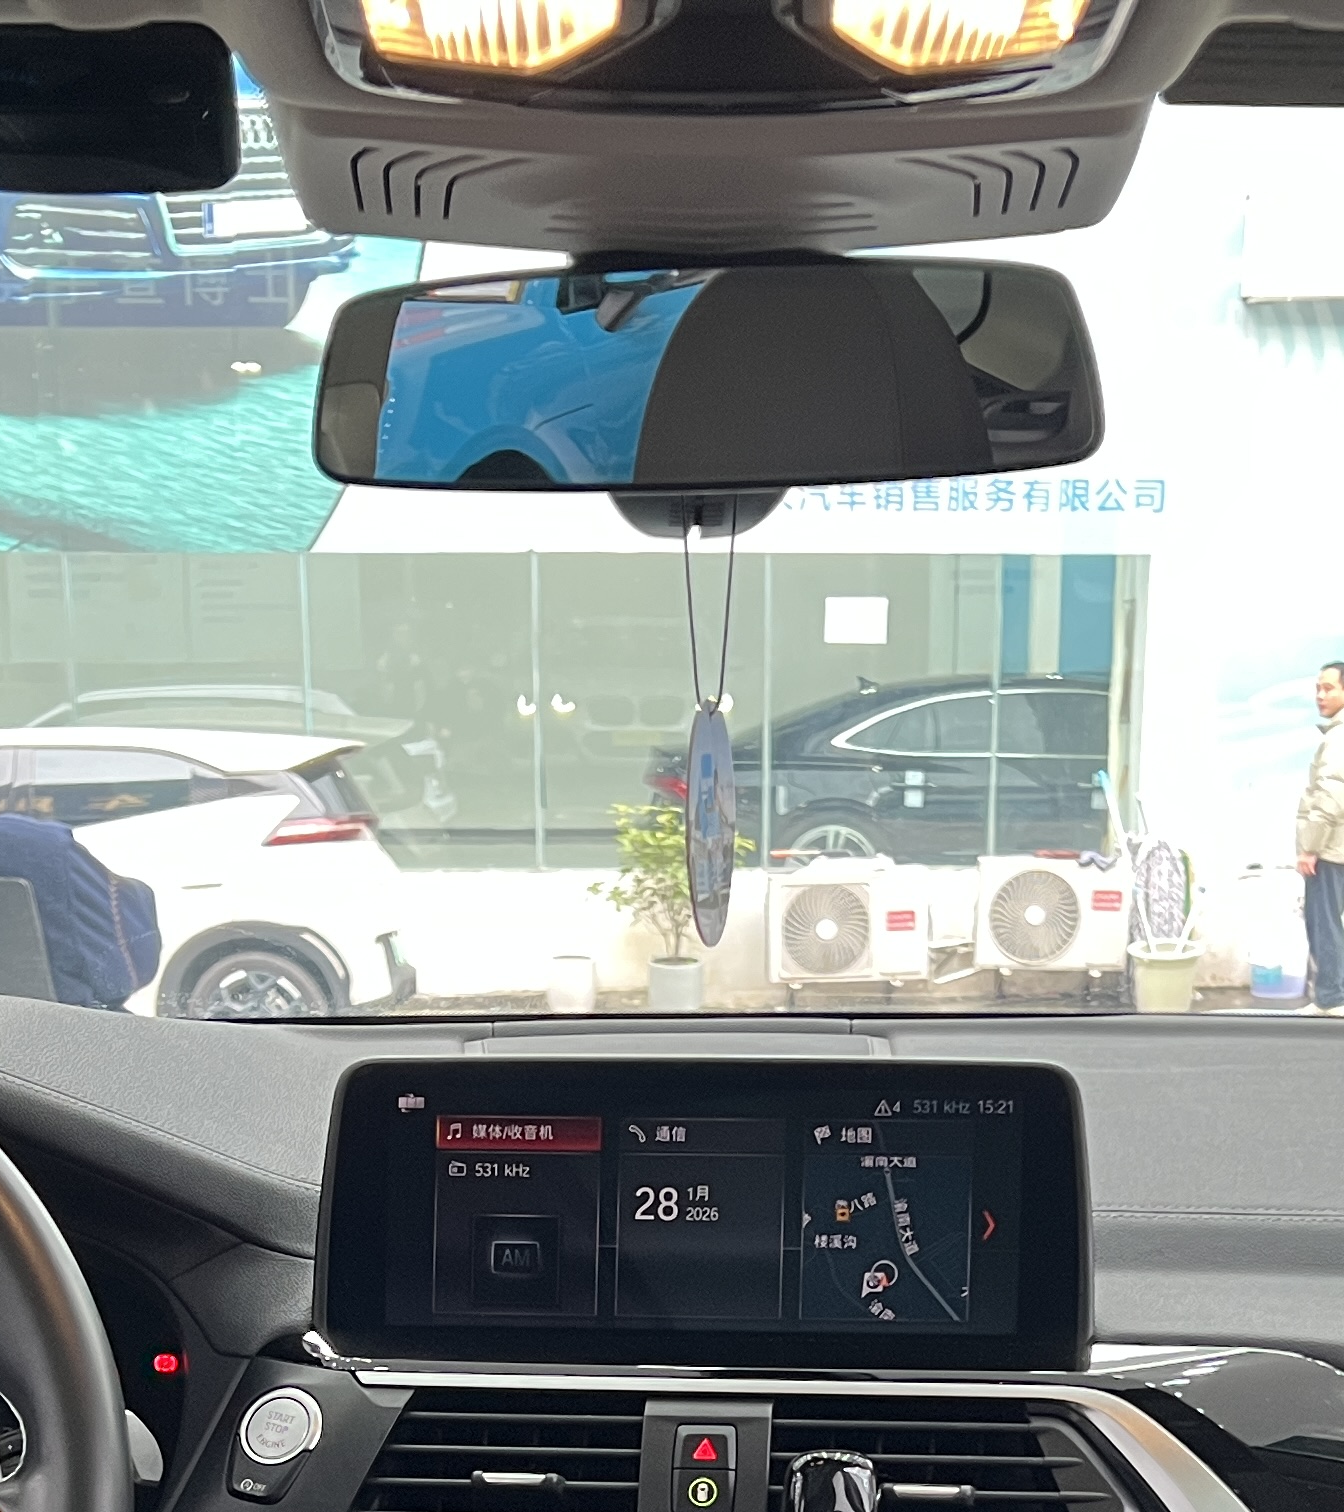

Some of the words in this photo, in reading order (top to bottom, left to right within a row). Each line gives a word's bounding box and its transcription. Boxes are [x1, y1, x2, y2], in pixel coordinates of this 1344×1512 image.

[783, 477, 1166, 513] 汽车销售服务有限公司
[912, 1100, 938, 1114] 531
[943, 1100, 970, 1114] kHz
[978, 1100, 1014, 1114] 15:21
[471, 1123, 554, 1142] 媒体/收音机
[655, 1125, 687, 1143] 通信
[840, 1127, 872, 1143] 地图
[474, 1163, 499, 1178] 531
[504, 1163, 531, 1179] kHz
[686, 1185, 709, 1202] 1月
[634, 1186, 679, 1222] 28
[685, 1207, 719, 1222] 2026
[501, 1248, 531, 1267] AM
[267, 1410, 296, 1425] START
[264, 1422, 289, 1434] STOP
[256, 1433, 286, 1449] ENGINE
